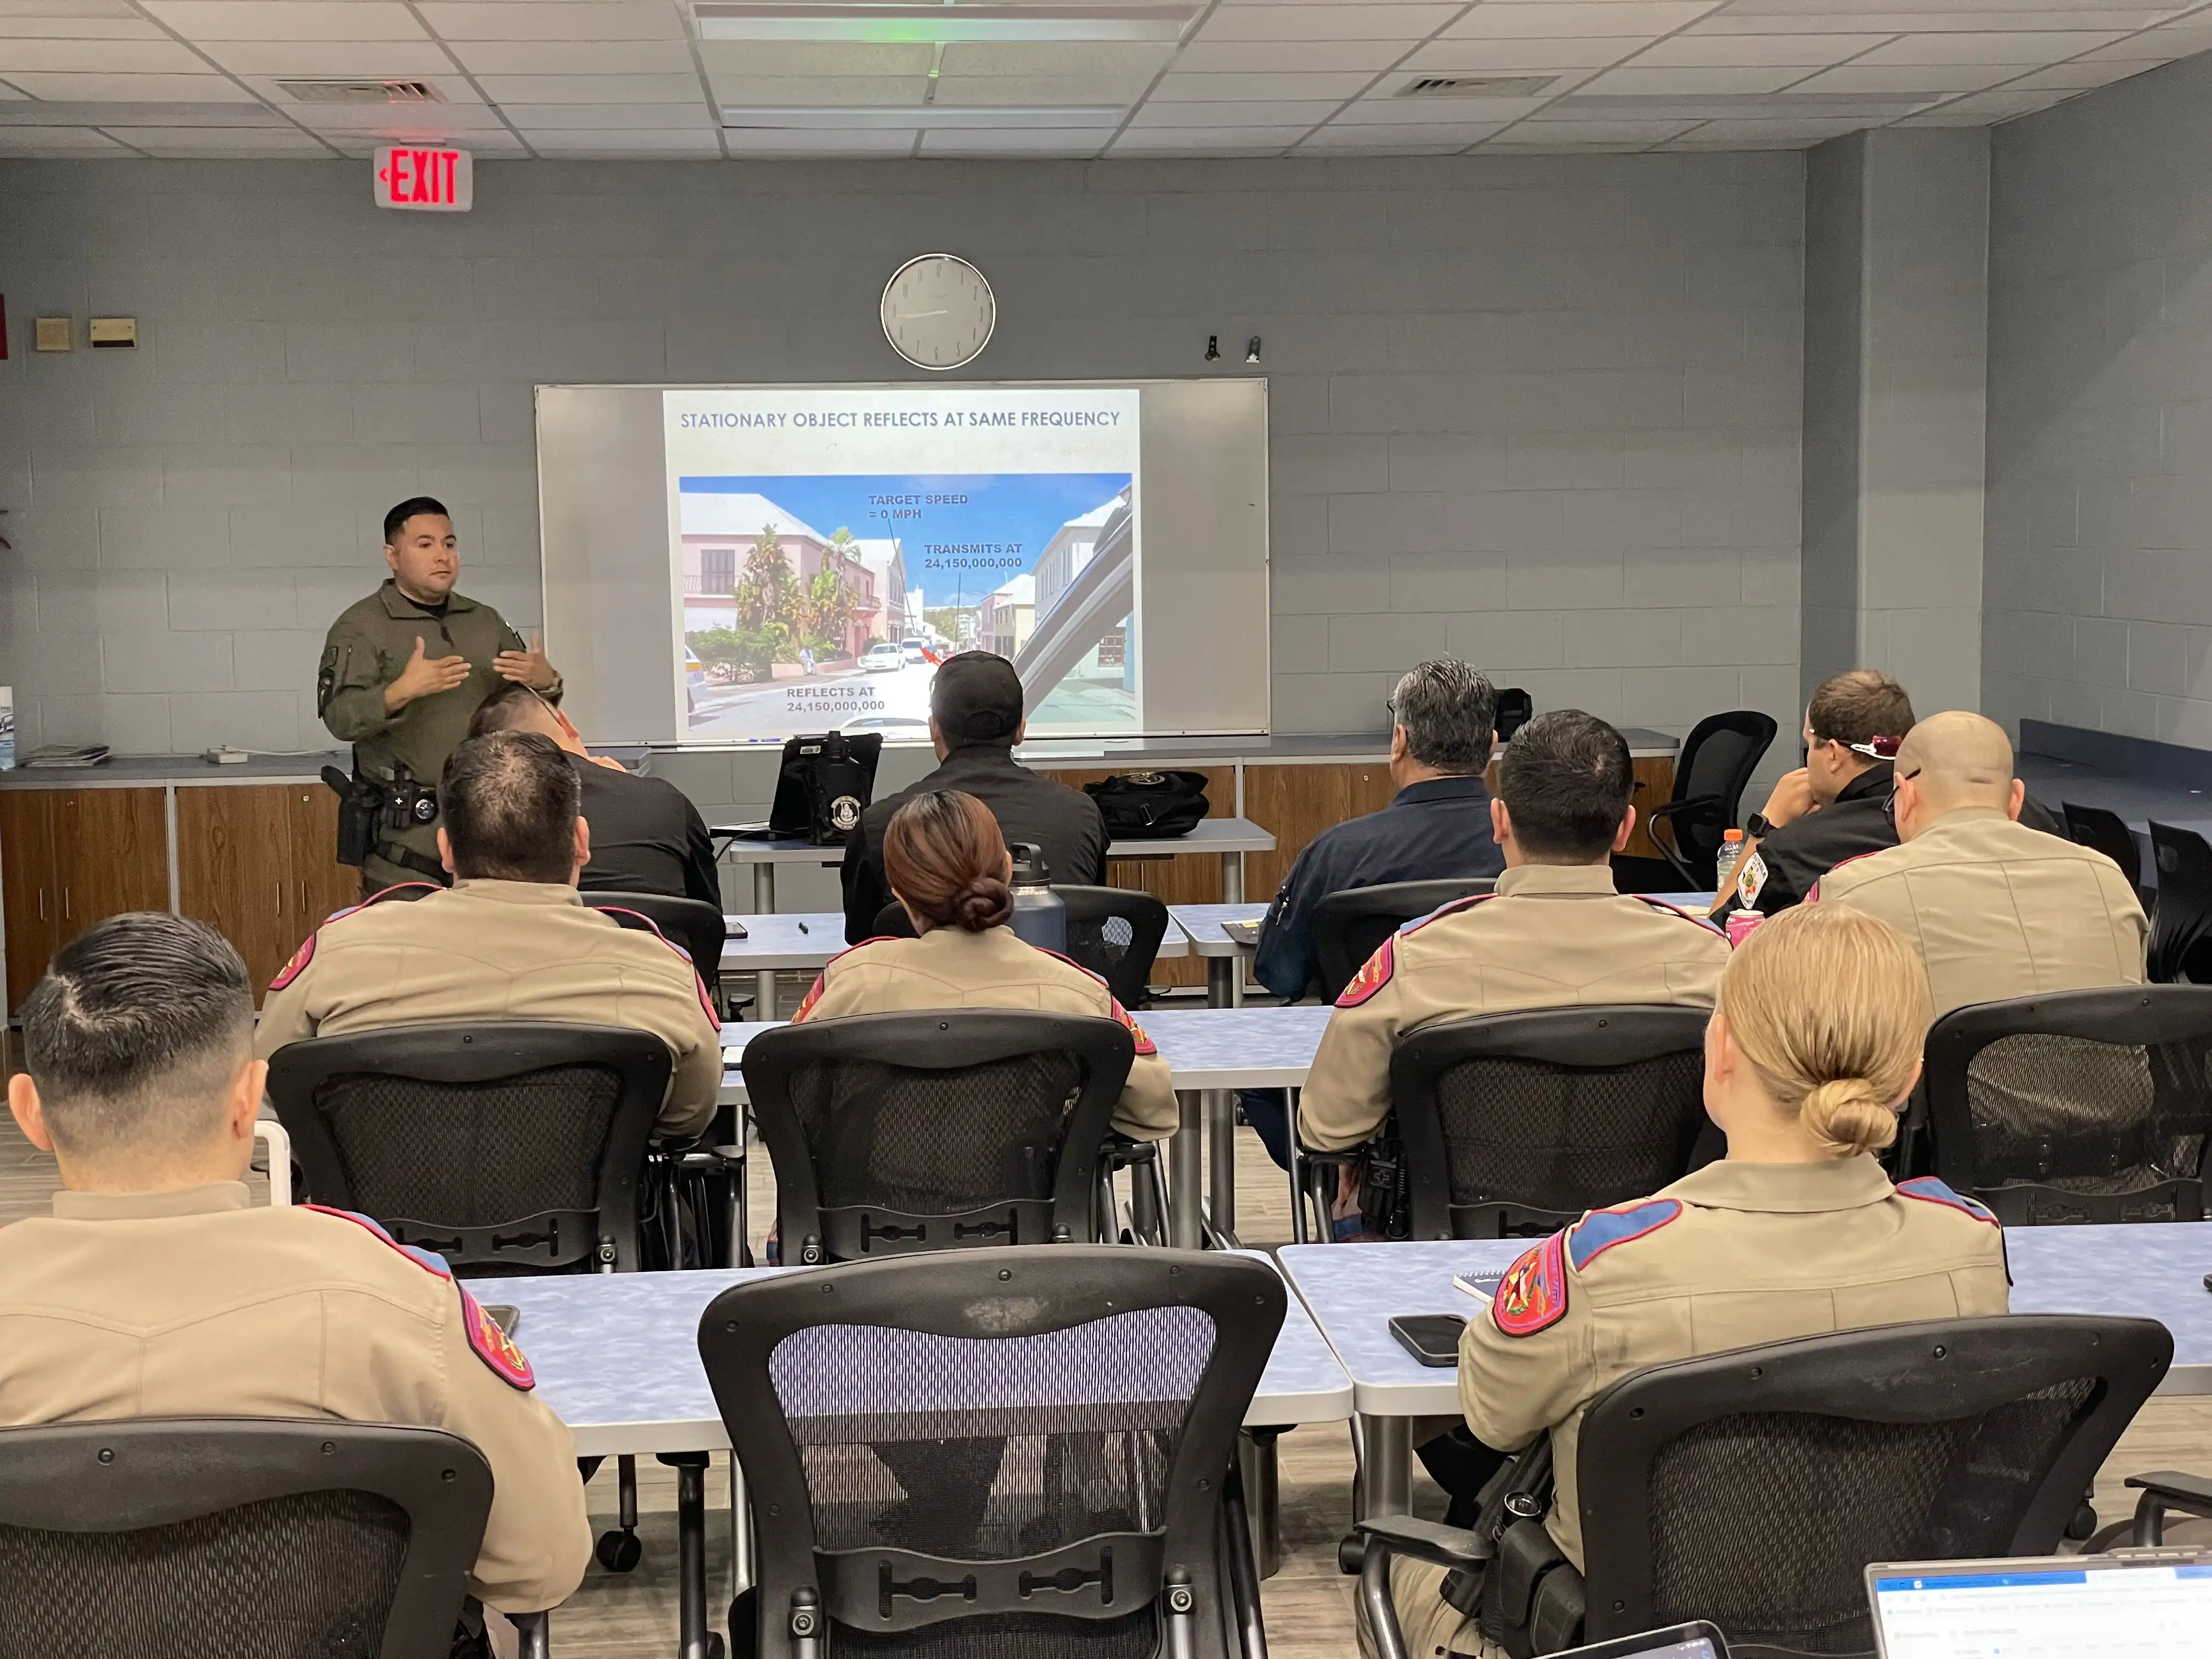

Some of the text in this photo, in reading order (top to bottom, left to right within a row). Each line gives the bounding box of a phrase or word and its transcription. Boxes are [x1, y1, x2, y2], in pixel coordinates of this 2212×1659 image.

[391, 149, 459, 205] EXIT
[681, 411, 1120, 428] STATIONARY OBJECT REFLECTS AT SAME FREQUENCY
[868, 494, 968, 505] TARGET SPEED
[881, 510, 888, 518] 0
[893, 509, 921, 518] MPH
[924, 544, 1022, 554] TRANSMITS AT
[925, 558, 1022, 570] 24,150,000,000
[787, 687, 875, 697] REFLECTS AT
[787, 701, 884, 713] 24,150,000,000
